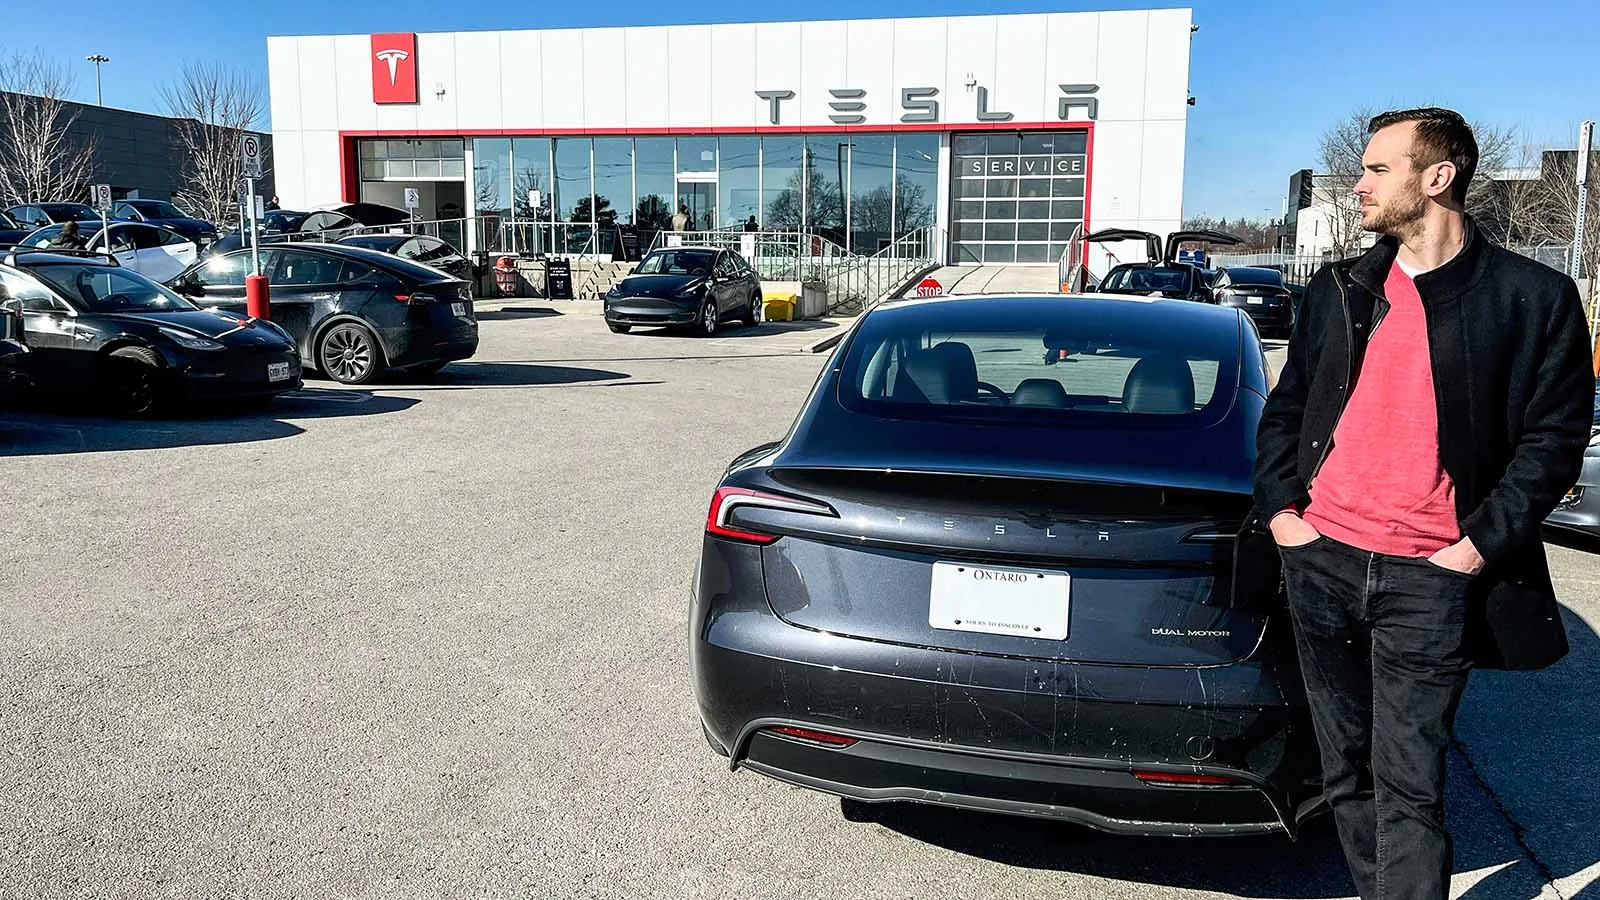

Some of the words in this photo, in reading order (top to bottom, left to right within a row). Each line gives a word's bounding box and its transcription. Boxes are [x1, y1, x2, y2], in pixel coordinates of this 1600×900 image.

[755, 84, 1100, 124] TESLA
[972, 160, 1081, 173] SERVICE
[917, 286, 942, 297] STOP
[896, 516, 1109, 541] TESLA
[973, 569, 1028, 583] ONTARIO
[1151, 628, 1185, 636] DUAL
